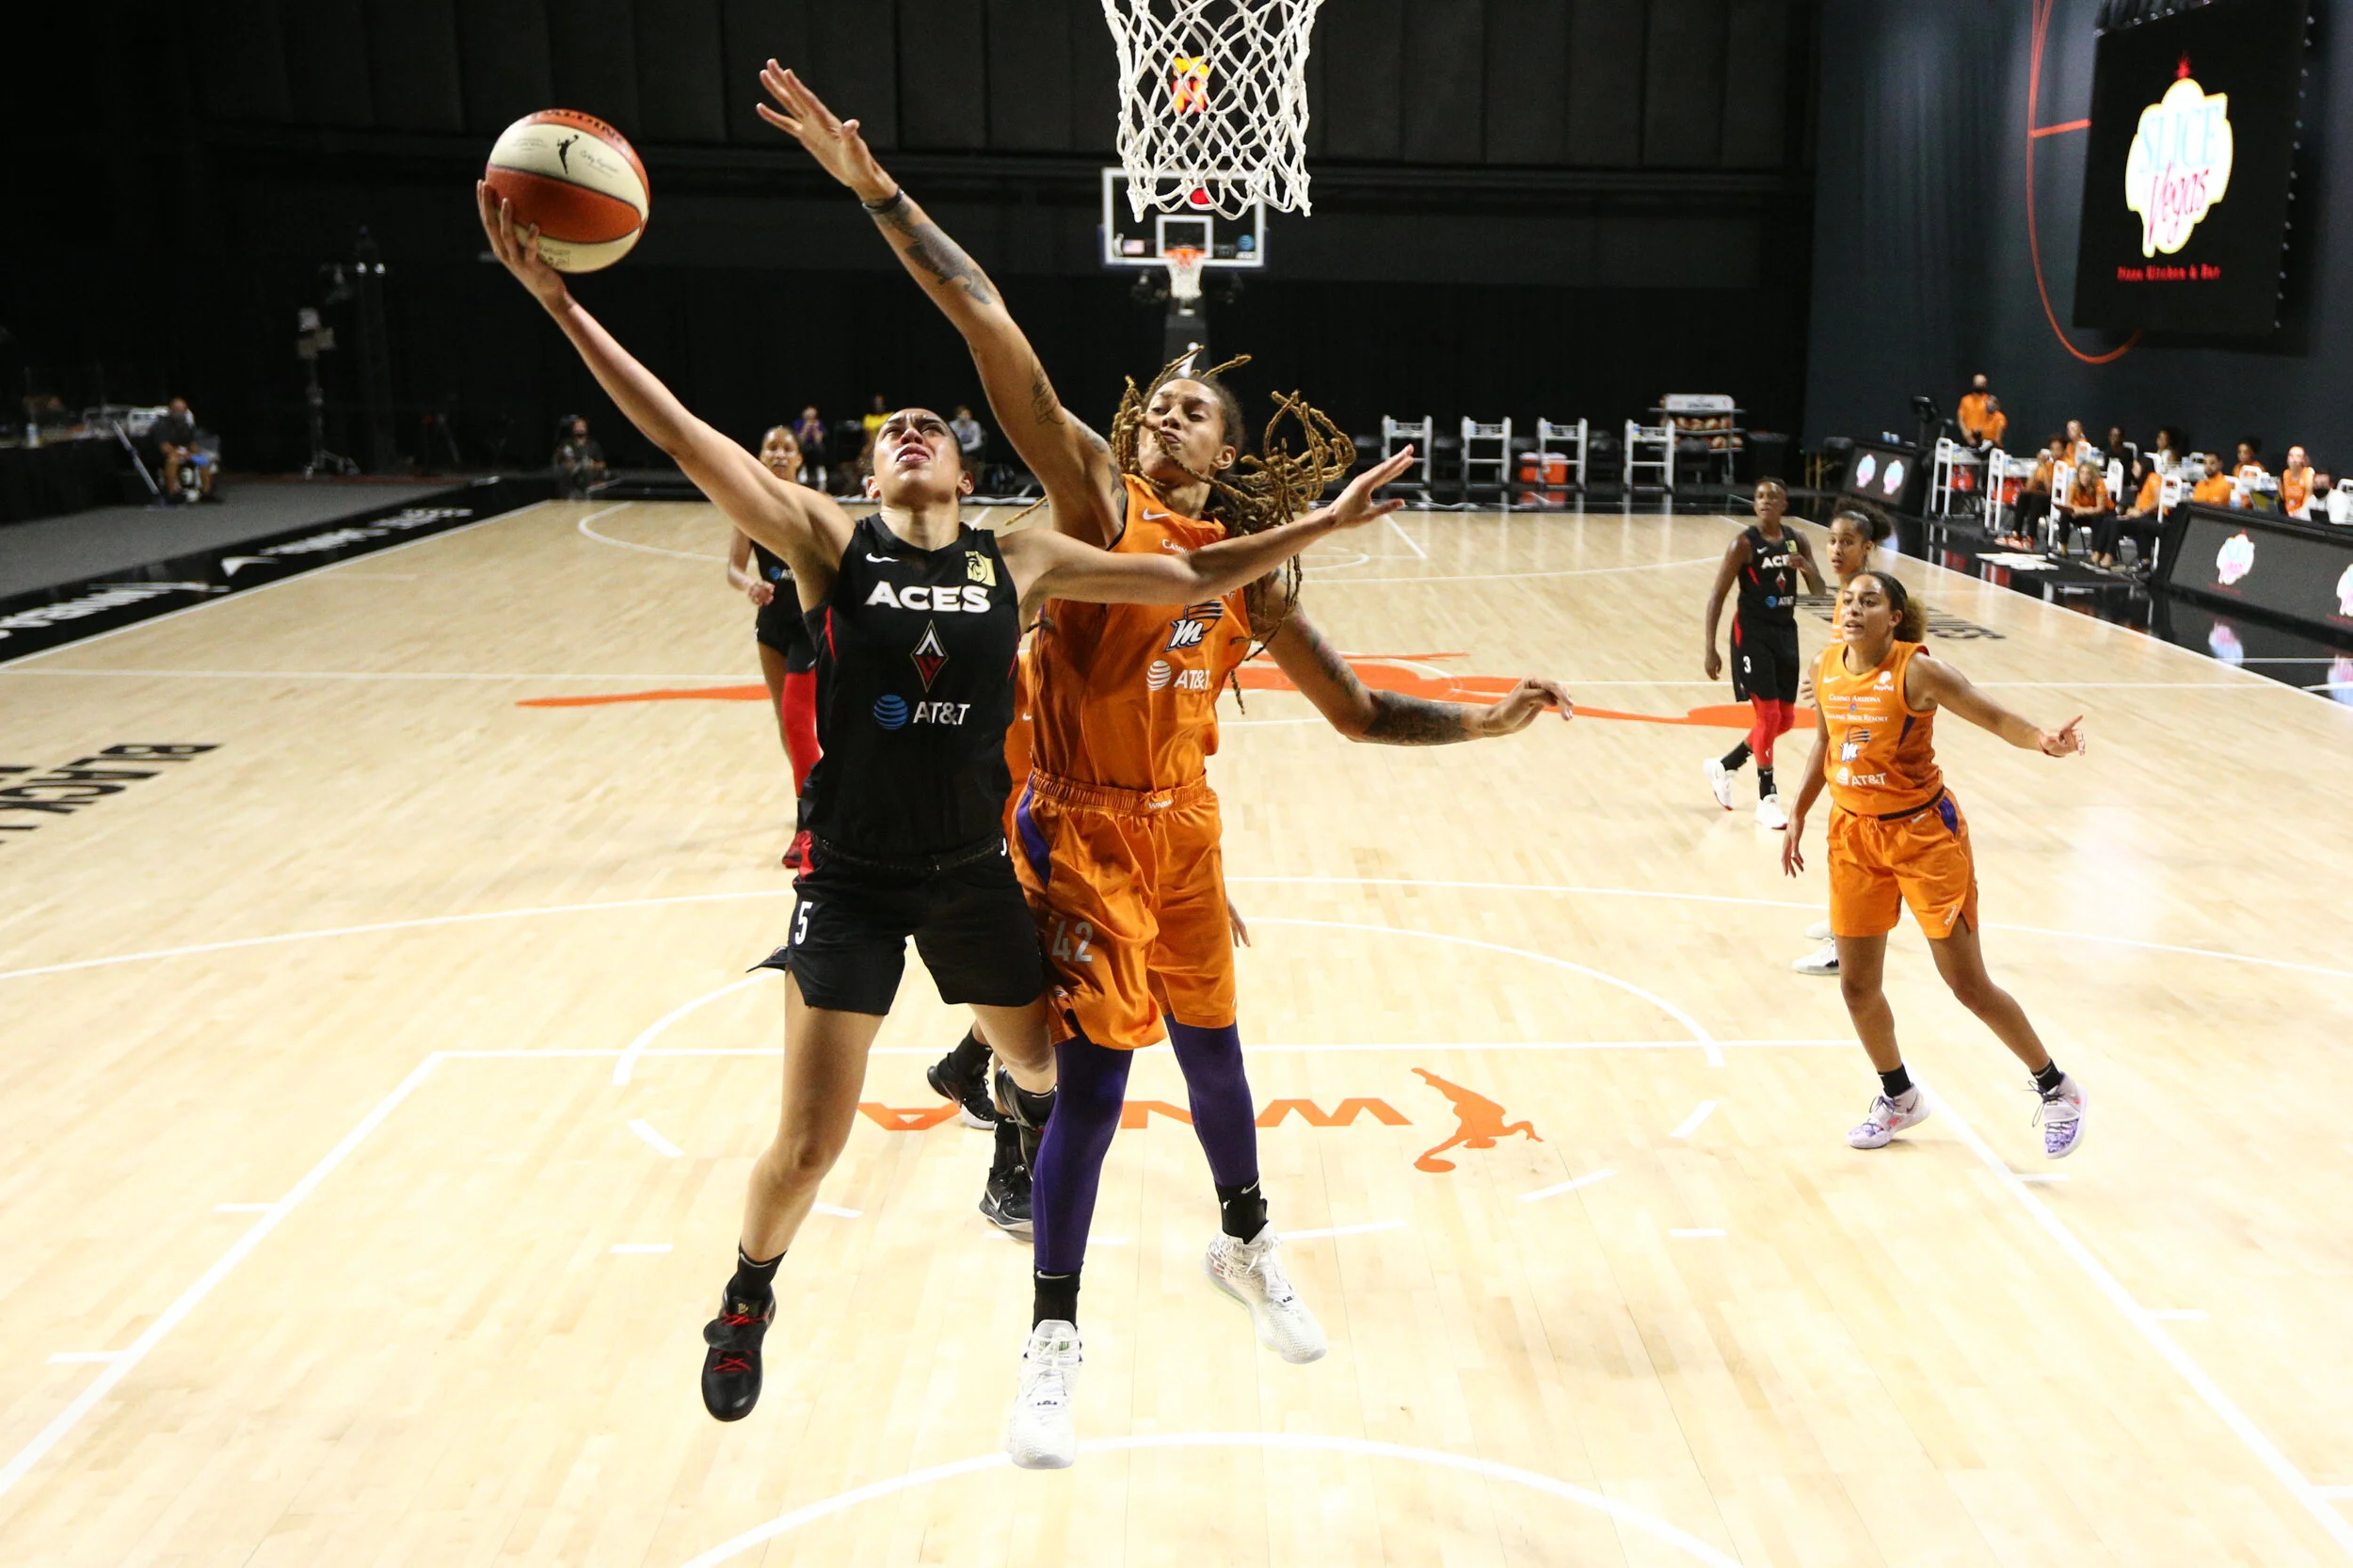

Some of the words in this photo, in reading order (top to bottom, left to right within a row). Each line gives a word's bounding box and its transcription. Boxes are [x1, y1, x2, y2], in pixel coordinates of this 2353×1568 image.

[2138, 105, 2220, 173] SLICE
[1761, 553, 1790, 569] ACE
[864, 580, 991, 614] ACES
[1742, 655, 1752, 674] 3
[1173, 669, 1211, 690] AT&T
[912, 700, 971, 726] AT&T
[1850, 772, 1887, 787] AT&T
[794, 900, 814, 945] 5
[1051, 920, 1095, 963] 42
[856, 1098, 1414, 1131] WNA
